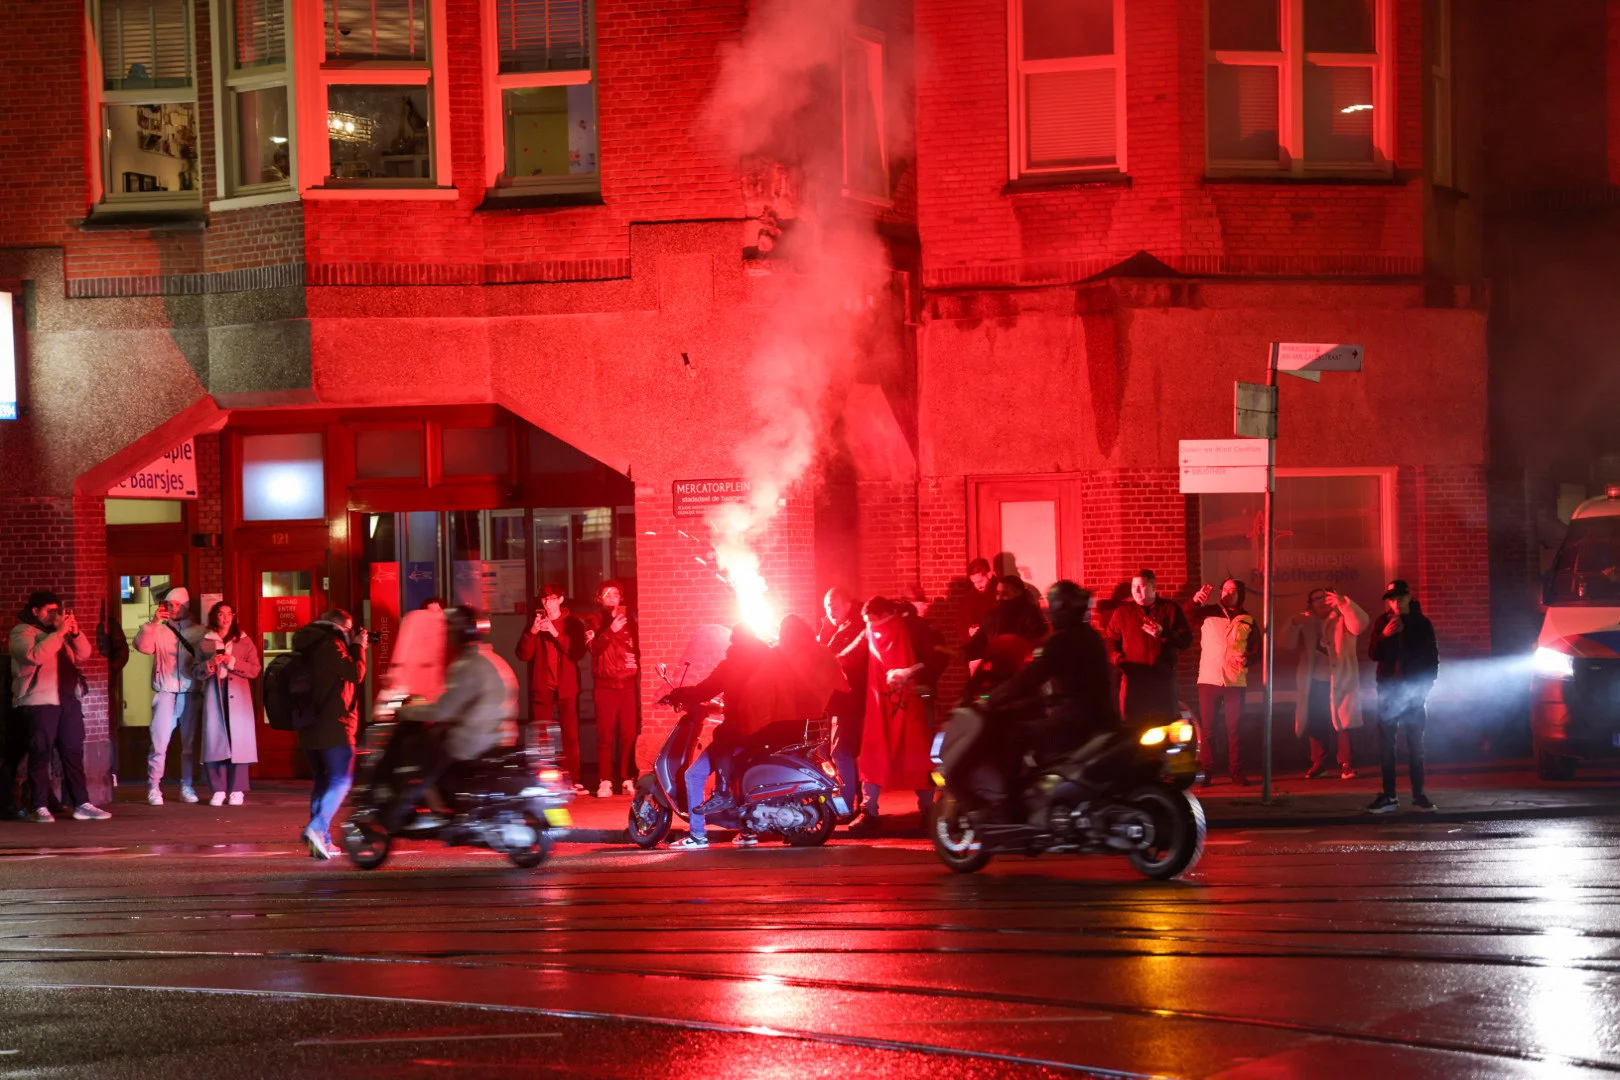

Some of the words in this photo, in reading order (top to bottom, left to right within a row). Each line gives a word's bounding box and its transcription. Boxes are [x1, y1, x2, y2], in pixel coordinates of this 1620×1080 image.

[130, 469, 184, 493] Baarsjes
[677, 482, 750, 494] MERCATORPLEIN
[272, 533, 289, 545] 121
[378, 616, 390, 666] Therapie
